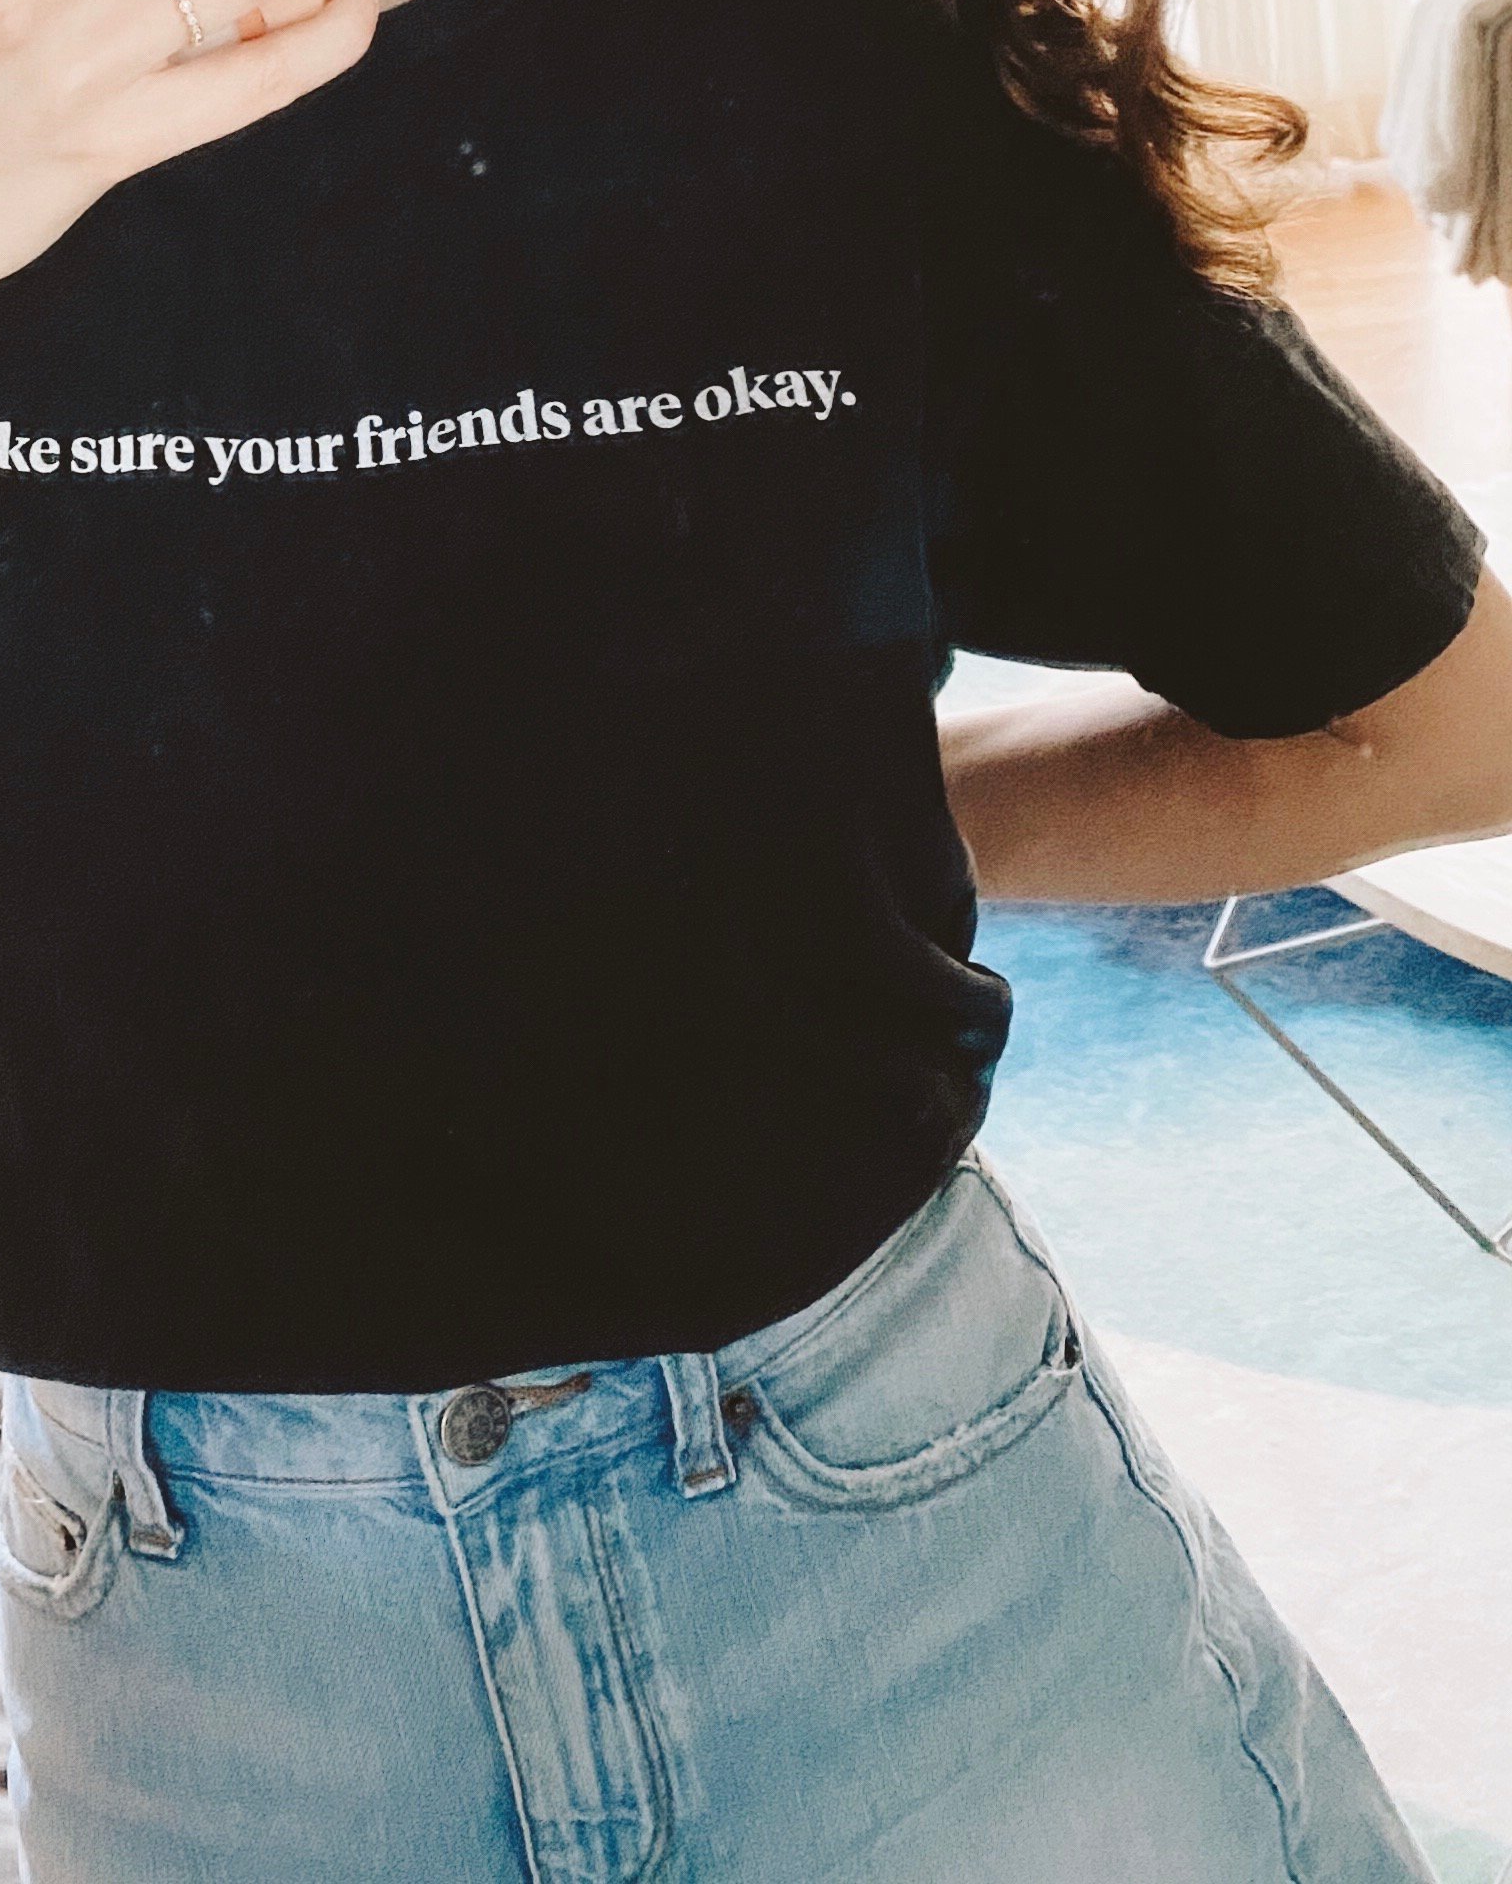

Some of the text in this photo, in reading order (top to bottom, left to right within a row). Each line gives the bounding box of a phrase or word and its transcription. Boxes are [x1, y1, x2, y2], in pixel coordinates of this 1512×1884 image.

[70, 432, 195, 475] sure
[203, 433, 345, 486] your
[352, 388, 572, 469] friends
[582, 392, 684, 437] are
[693, 365, 857, 422] okay.
